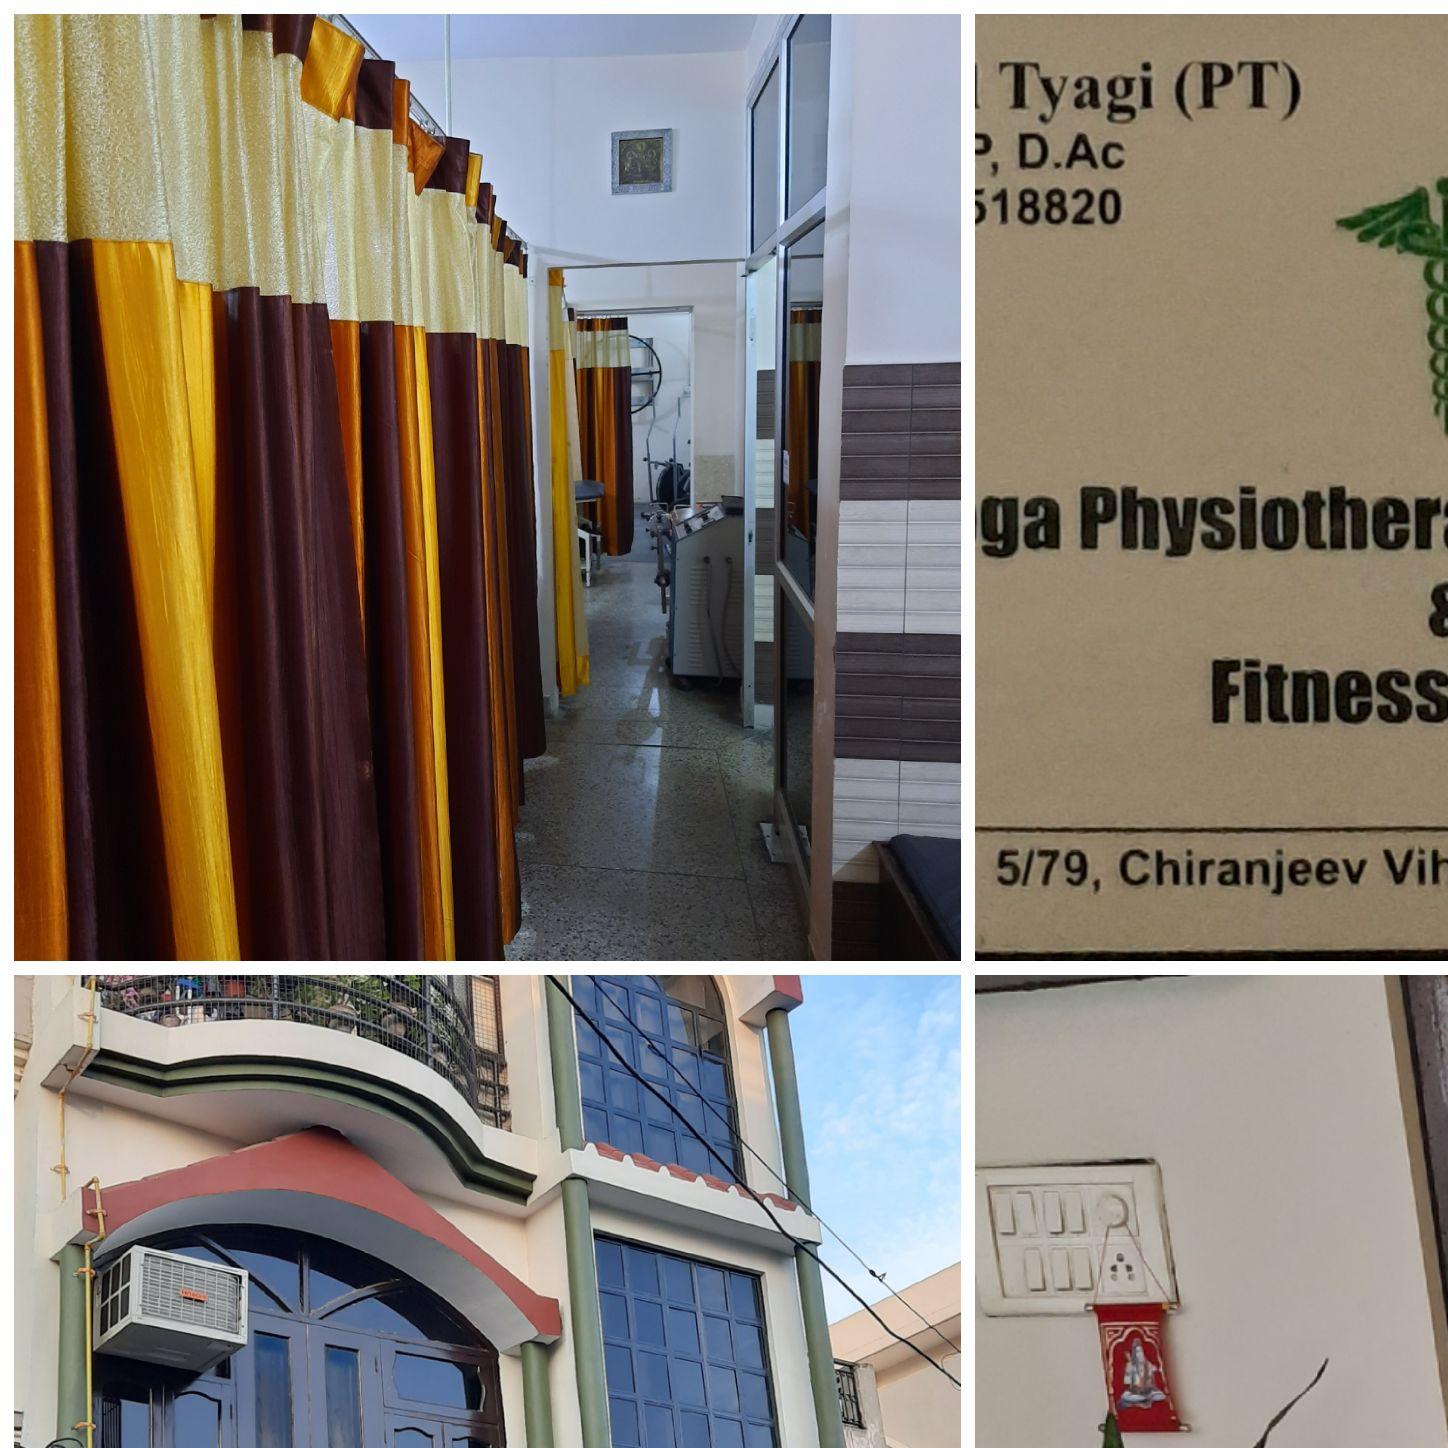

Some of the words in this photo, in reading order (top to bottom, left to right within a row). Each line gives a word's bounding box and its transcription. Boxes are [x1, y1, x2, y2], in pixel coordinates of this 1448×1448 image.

[999, 61, 1154, 125] Tyagi
[1174, 61, 1301, 121] (PT)
[1018, 132, 1125, 170] D.Ac
[975, 495, 1061, 559] ga
[997, 848, 1100, 894] 5/79,
[1119, 849, 1367, 896] Chiranjeev
